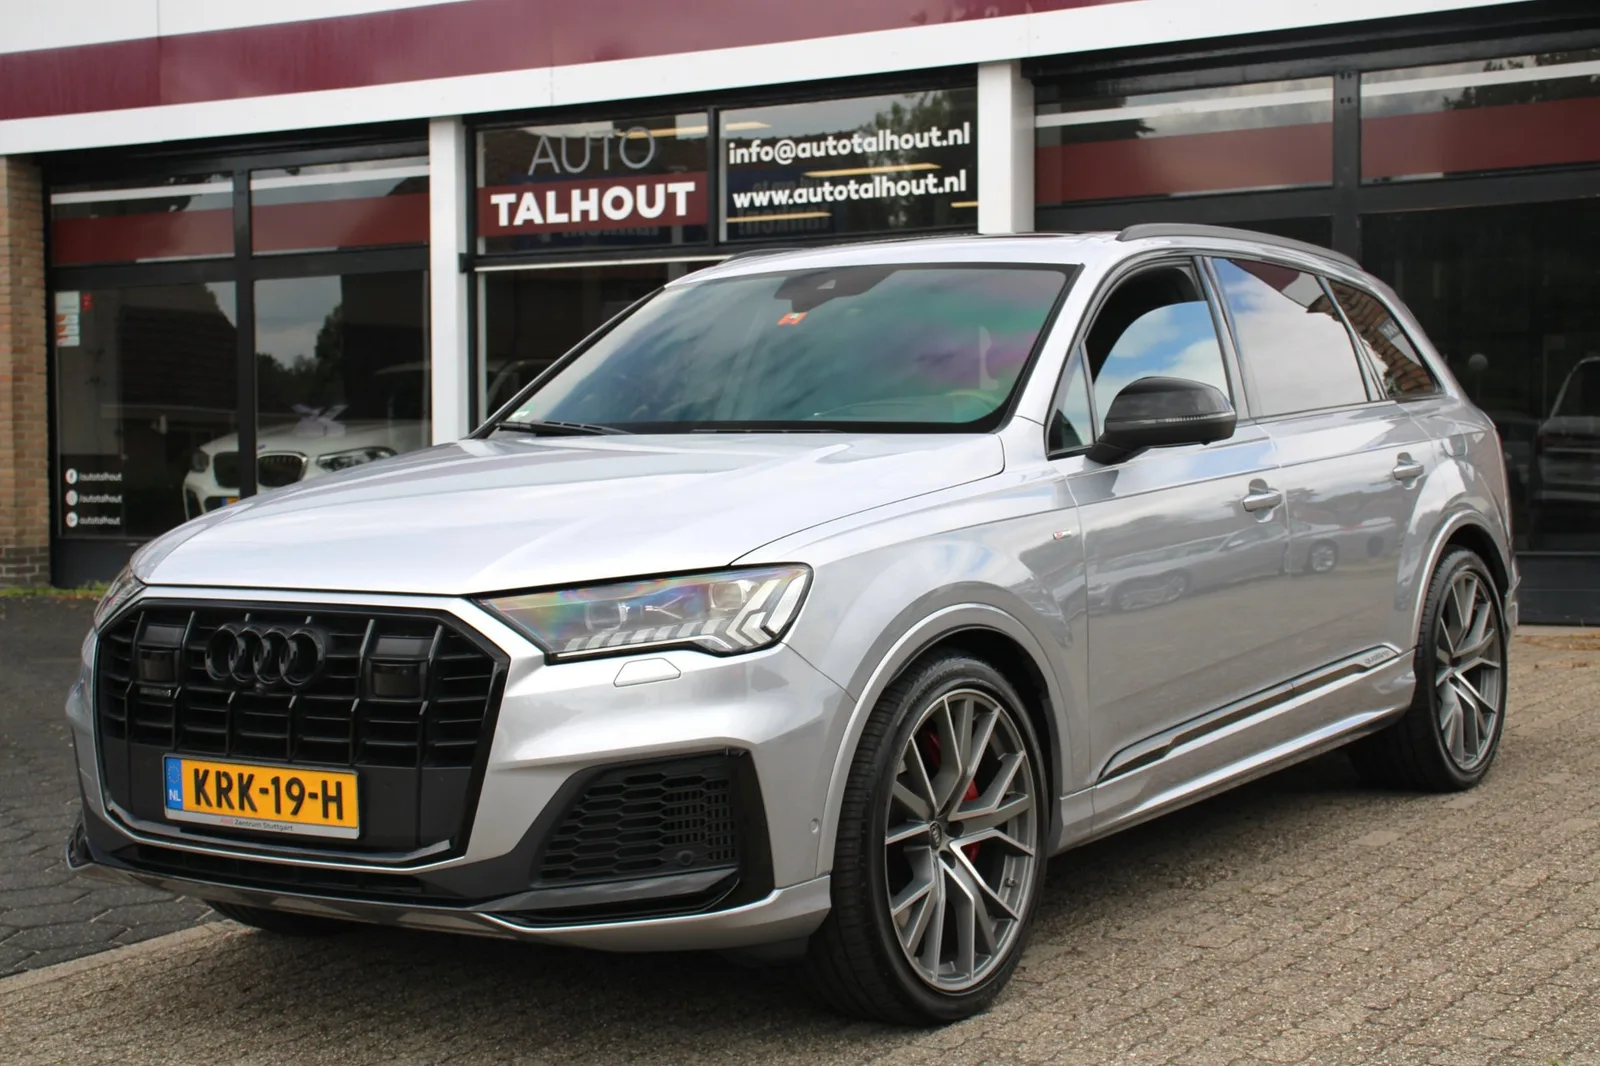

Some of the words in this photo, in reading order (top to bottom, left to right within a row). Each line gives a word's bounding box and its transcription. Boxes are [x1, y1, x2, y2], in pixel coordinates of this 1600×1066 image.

[528, 125, 656, 176] AUTO
[728, 122, 971, 165] info@autotalhout.nl
[490, 182, 696, 227] TALHOUT
[732, 169, 967, 209] www.autotalhout.nl
[168, 789, 181, 802] NL
[193, 767, 344, 820] KRK-19-H
[234, 819, 262, 828] Zentrum
[262, 822, 294, 832] Stuttgart
